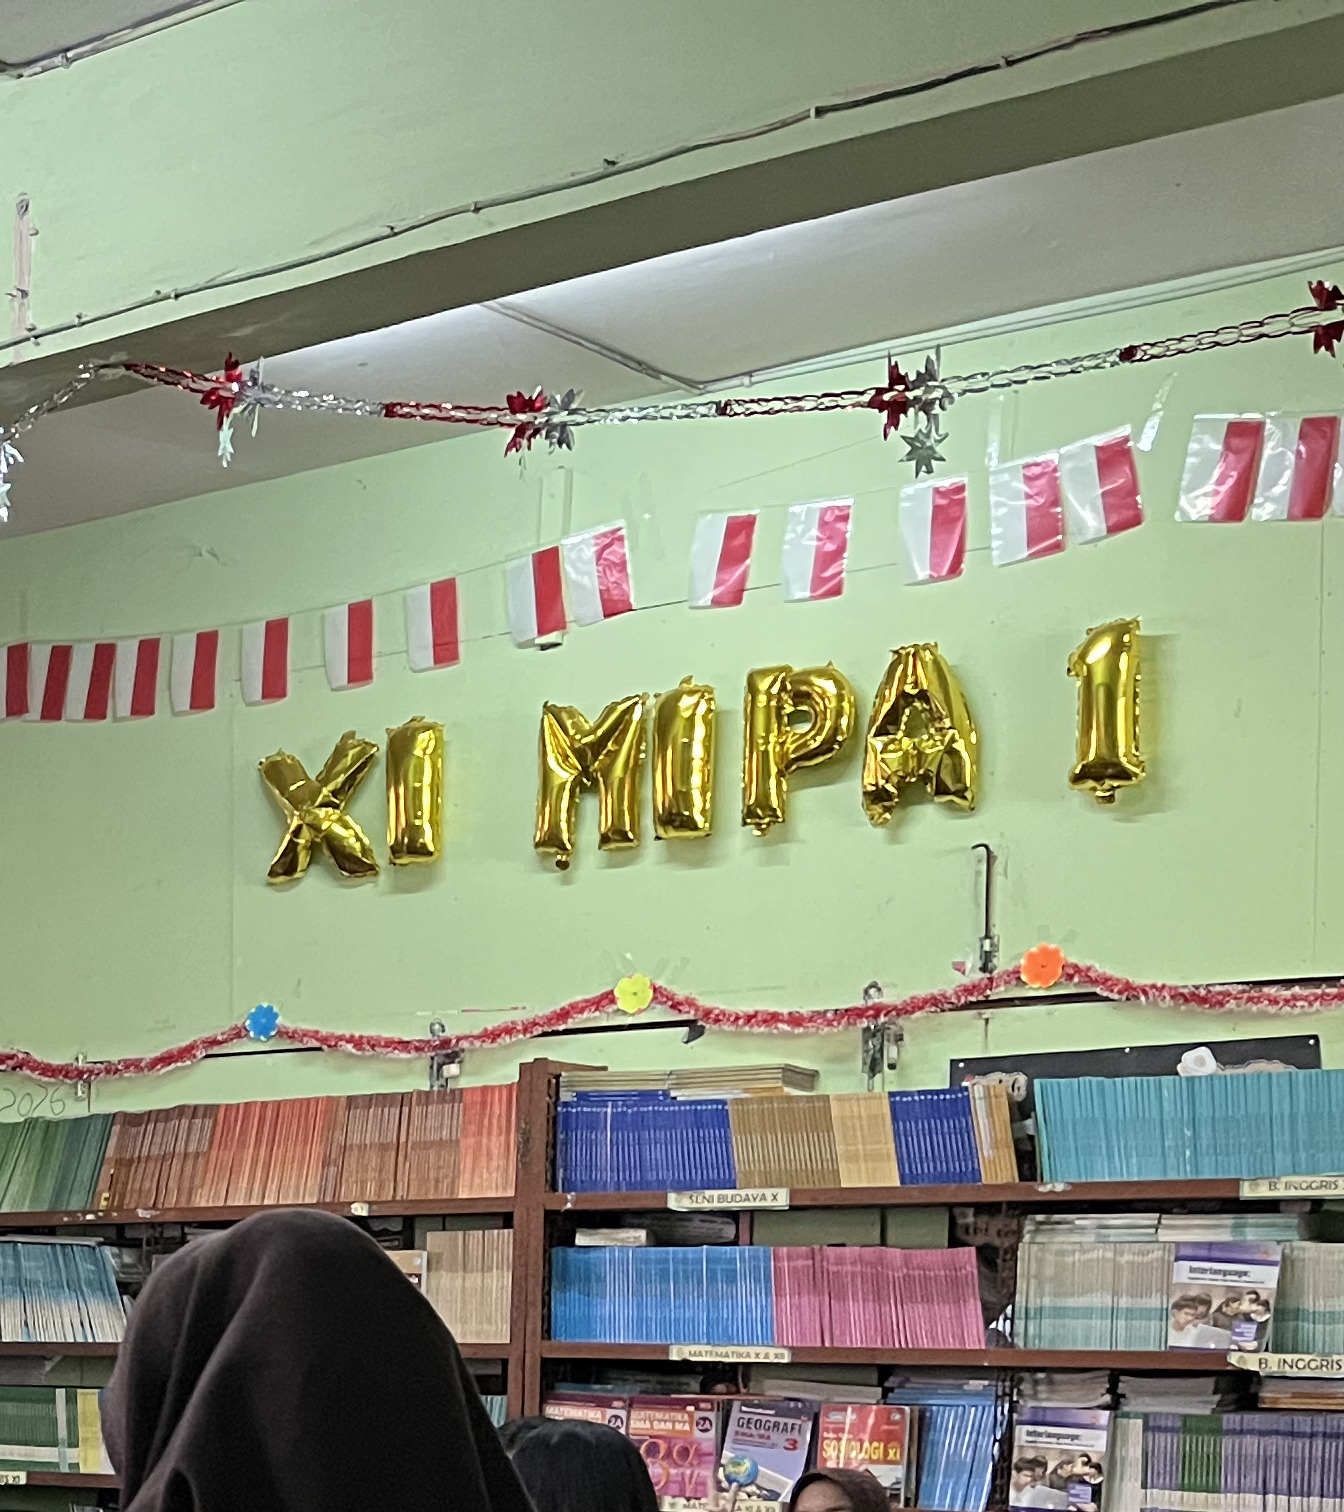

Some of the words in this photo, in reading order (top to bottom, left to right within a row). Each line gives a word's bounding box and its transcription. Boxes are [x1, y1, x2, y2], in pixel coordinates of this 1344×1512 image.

[258, 714, 445, 885] XI
[533, 640, 977, 870] MIPA
[1065, 614, 1146, 804] 1
[1284, 1179, 1339, 1192] INGGRIS
[716, 1192, 768, 1205] BUDAYA
[771, 1192, 779, 1202] X
[688, 1349, 752, 1360] MATEMATIKA
[1258, 1357, 1273, 1370] B.
[1277, 1357, 1343, 1371] INGGRIS
[696, 1419, 712, 1431] 2A
[737, 1416, 803, 1435] GEOGRAFI
[783, 1437, 799, 1451] 3
